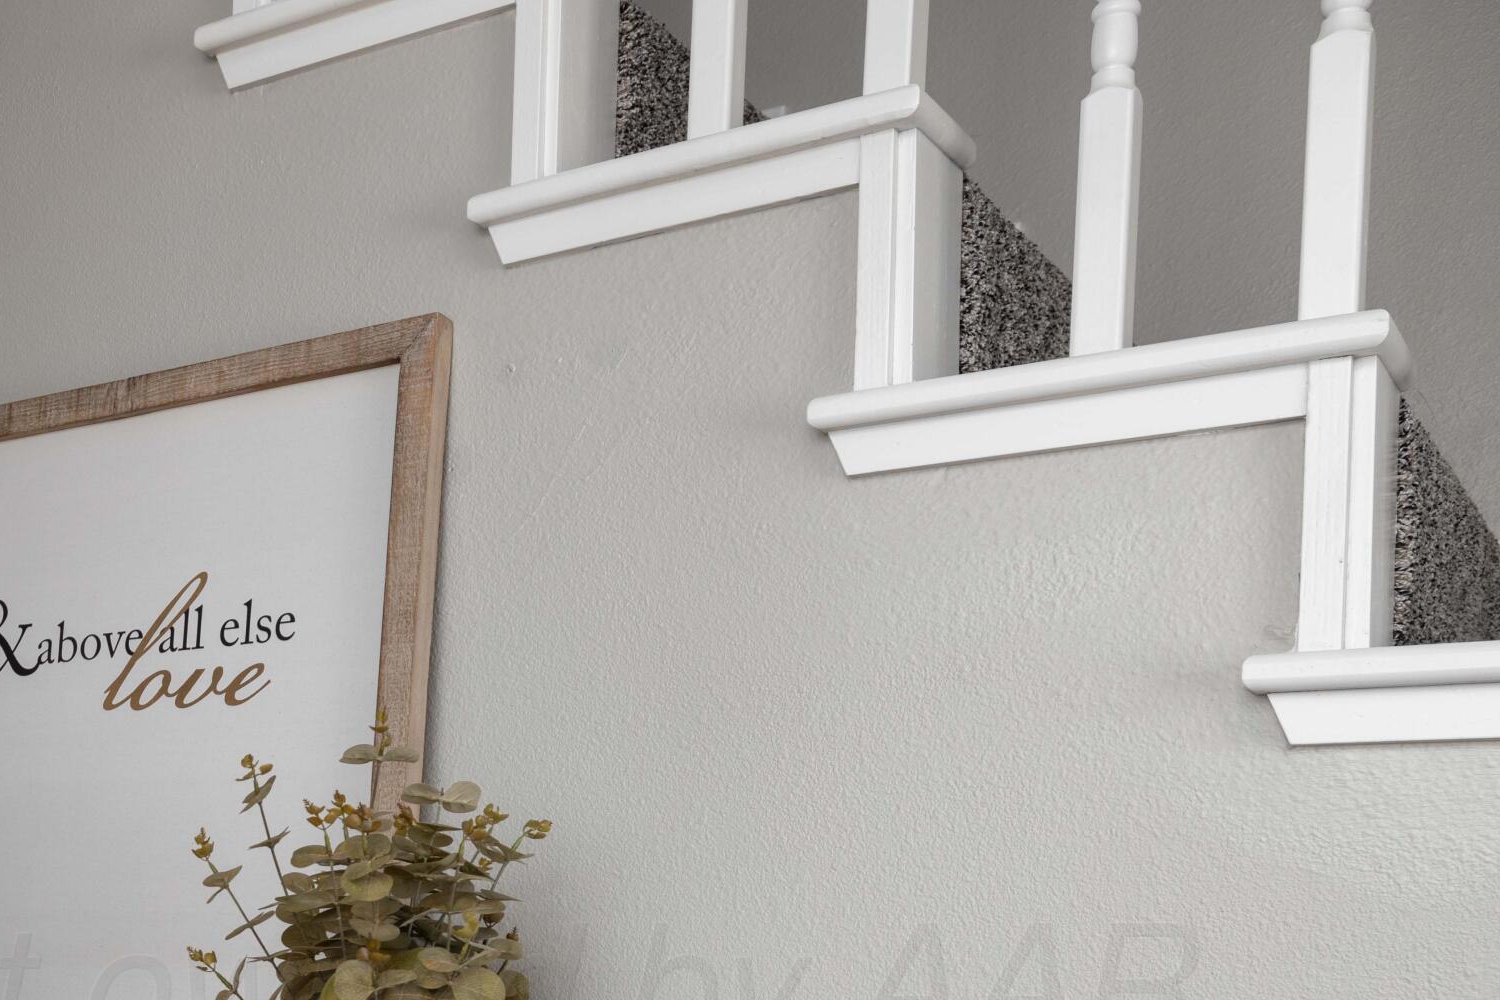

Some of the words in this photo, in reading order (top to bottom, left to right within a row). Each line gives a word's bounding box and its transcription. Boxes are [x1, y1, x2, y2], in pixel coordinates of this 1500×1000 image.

[37, 620, 144, 666] above
[157, 604, 205, 654] all
[218, 598, 297, 648] else
[102, 571, 272, 712] love
